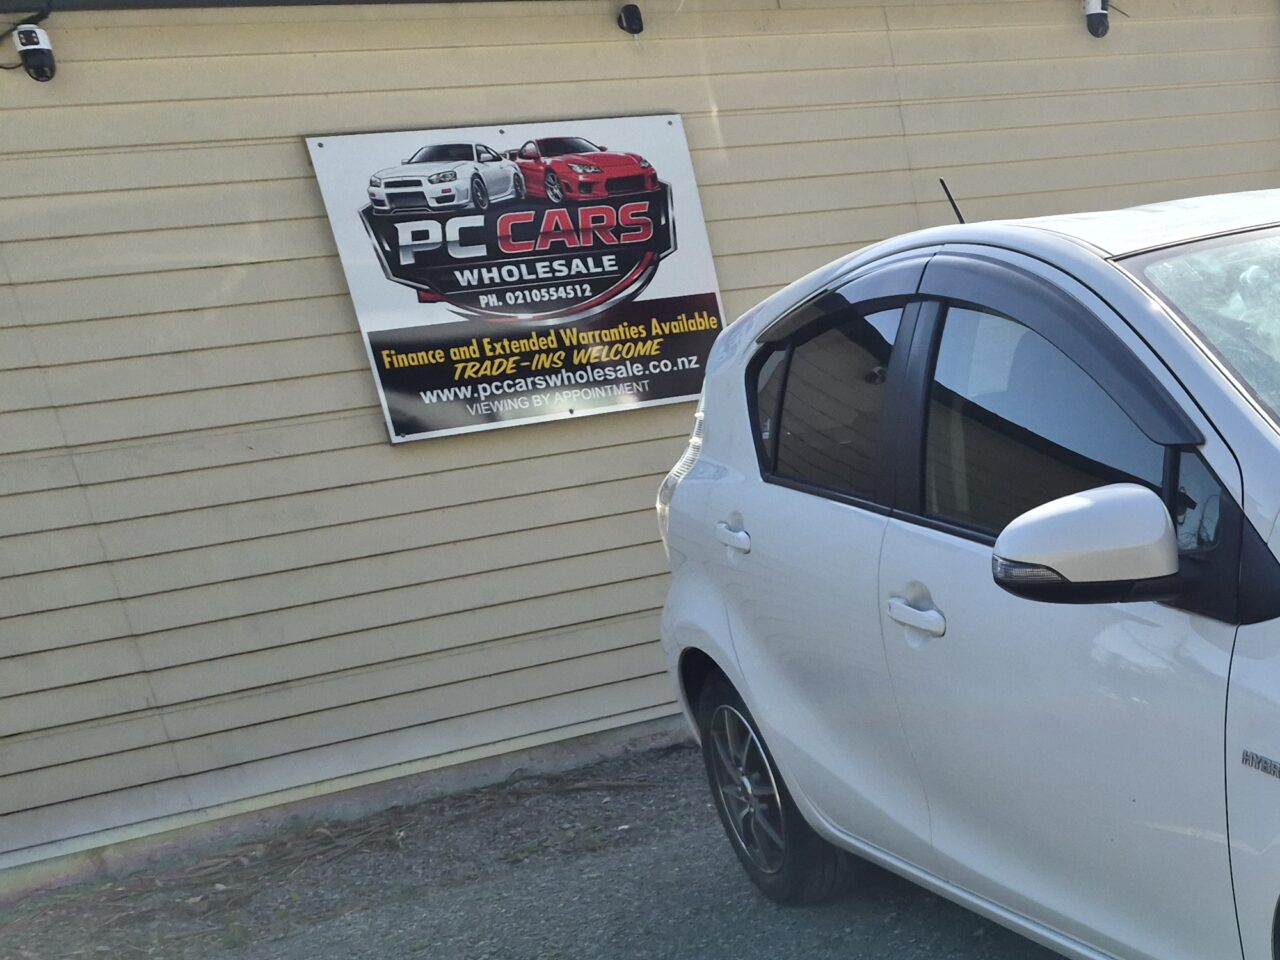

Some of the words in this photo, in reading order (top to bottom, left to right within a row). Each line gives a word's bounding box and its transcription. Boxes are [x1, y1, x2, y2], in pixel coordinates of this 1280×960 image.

[394, 214, 488, 265] PC
[496, 201, 654, 254] CARS
[453, 254, 619, 287] WHOLESALE
[479, 293, 503, 308] PH.
[506, 284, 592, 305] 0210554512
[381, 348, 445, 369] Finance
[450, 338, 480, 360] and
[482, 329, 558, 356] Extended
[559, 321, 647, 347] Warranties
[651, 311, 718, 336] Available
[454, 350, 566, 381] TRADE-INS
[573, 338, 664, 366] WELCOME
[420, 355, 700, 404] www.pccarswholesale.co.nz
[466, 397, 530, 416] VIEWING
[532, 393, 551, 408] BY
[554, 379, 650, 405] APPOINTMENT
